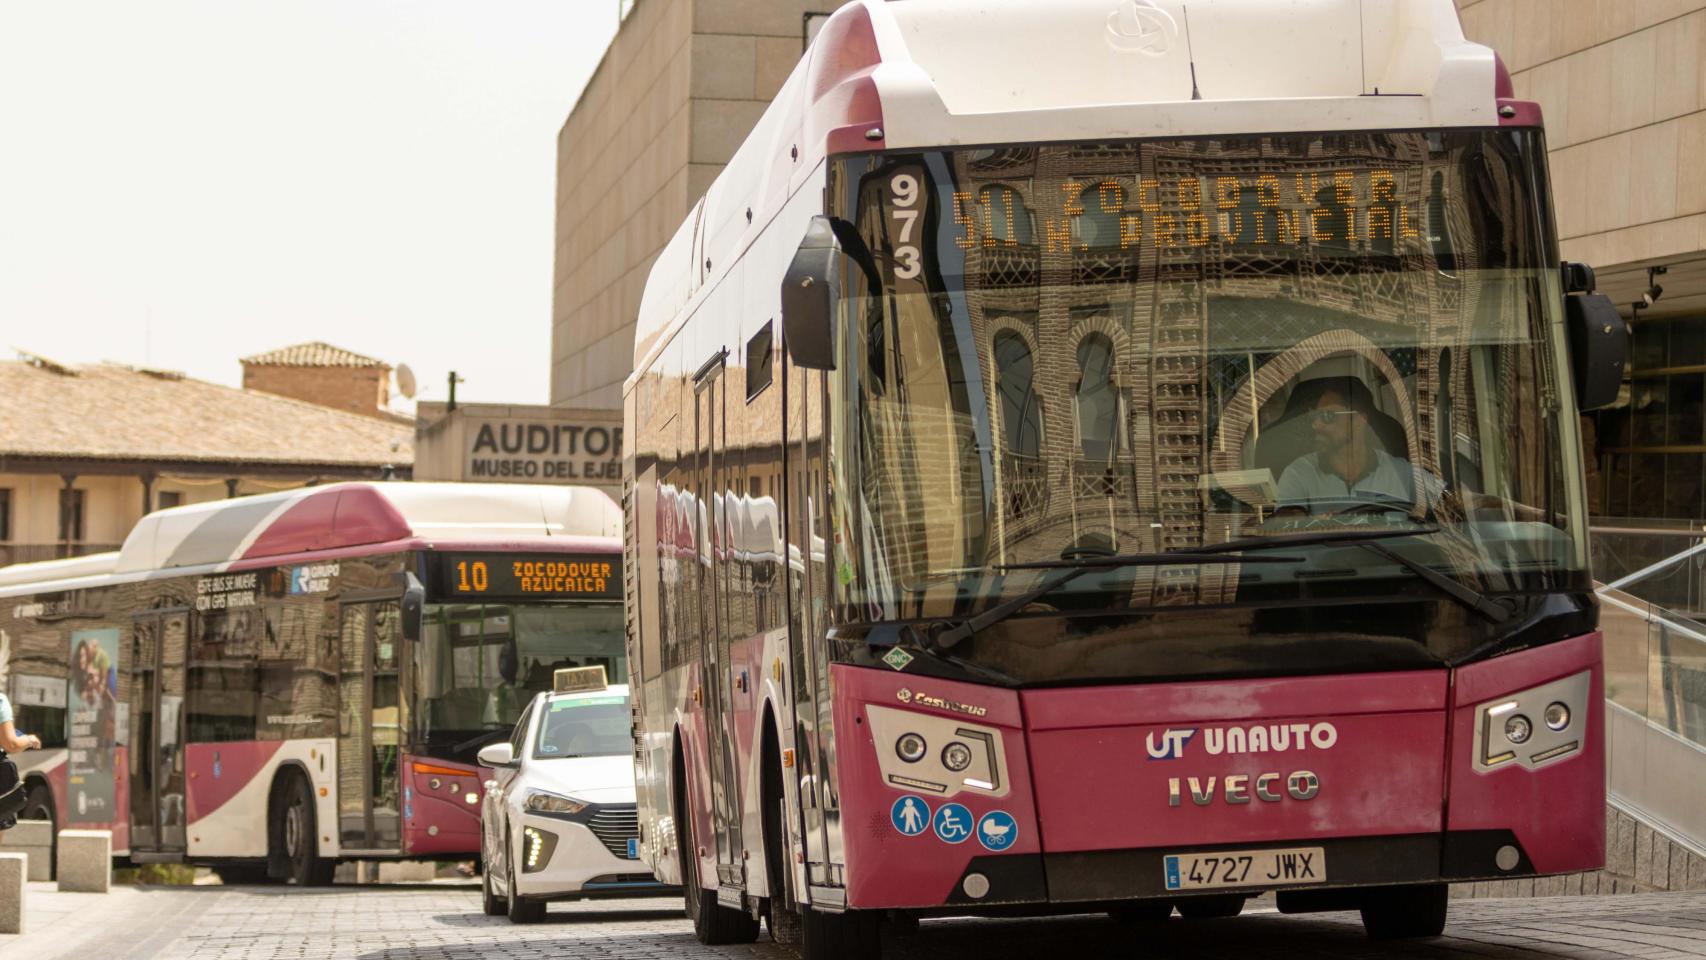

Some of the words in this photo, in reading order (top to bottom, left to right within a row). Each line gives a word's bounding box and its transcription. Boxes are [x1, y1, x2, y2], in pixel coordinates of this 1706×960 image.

[952, 189, 1018, 248] 511
[1061, 169, 1395, 216] ZOCODOVER
[891, 174, 921, 279] 973
[1119, 204, 1419, 249] PROVINCIAL
[472, 458, 538, 477] MUSEO
[543, 461, 578, 478] DEL
[309, 578, 330, 593] RUIZ
[311, 564, 340, 577] GRUPO
[457, 560, 488, 592] 10
[513, 561, 612, 578] ZOCODOVER
[521, 577, 606, 592] AZUCAICA
[1204, 722, 1337, 755] UNAUTO
[1168, 770, 1319, 807] IVECO
[1188, 856, 1253, 884] 4727
[1266, 853, 1314, 880] JWX
